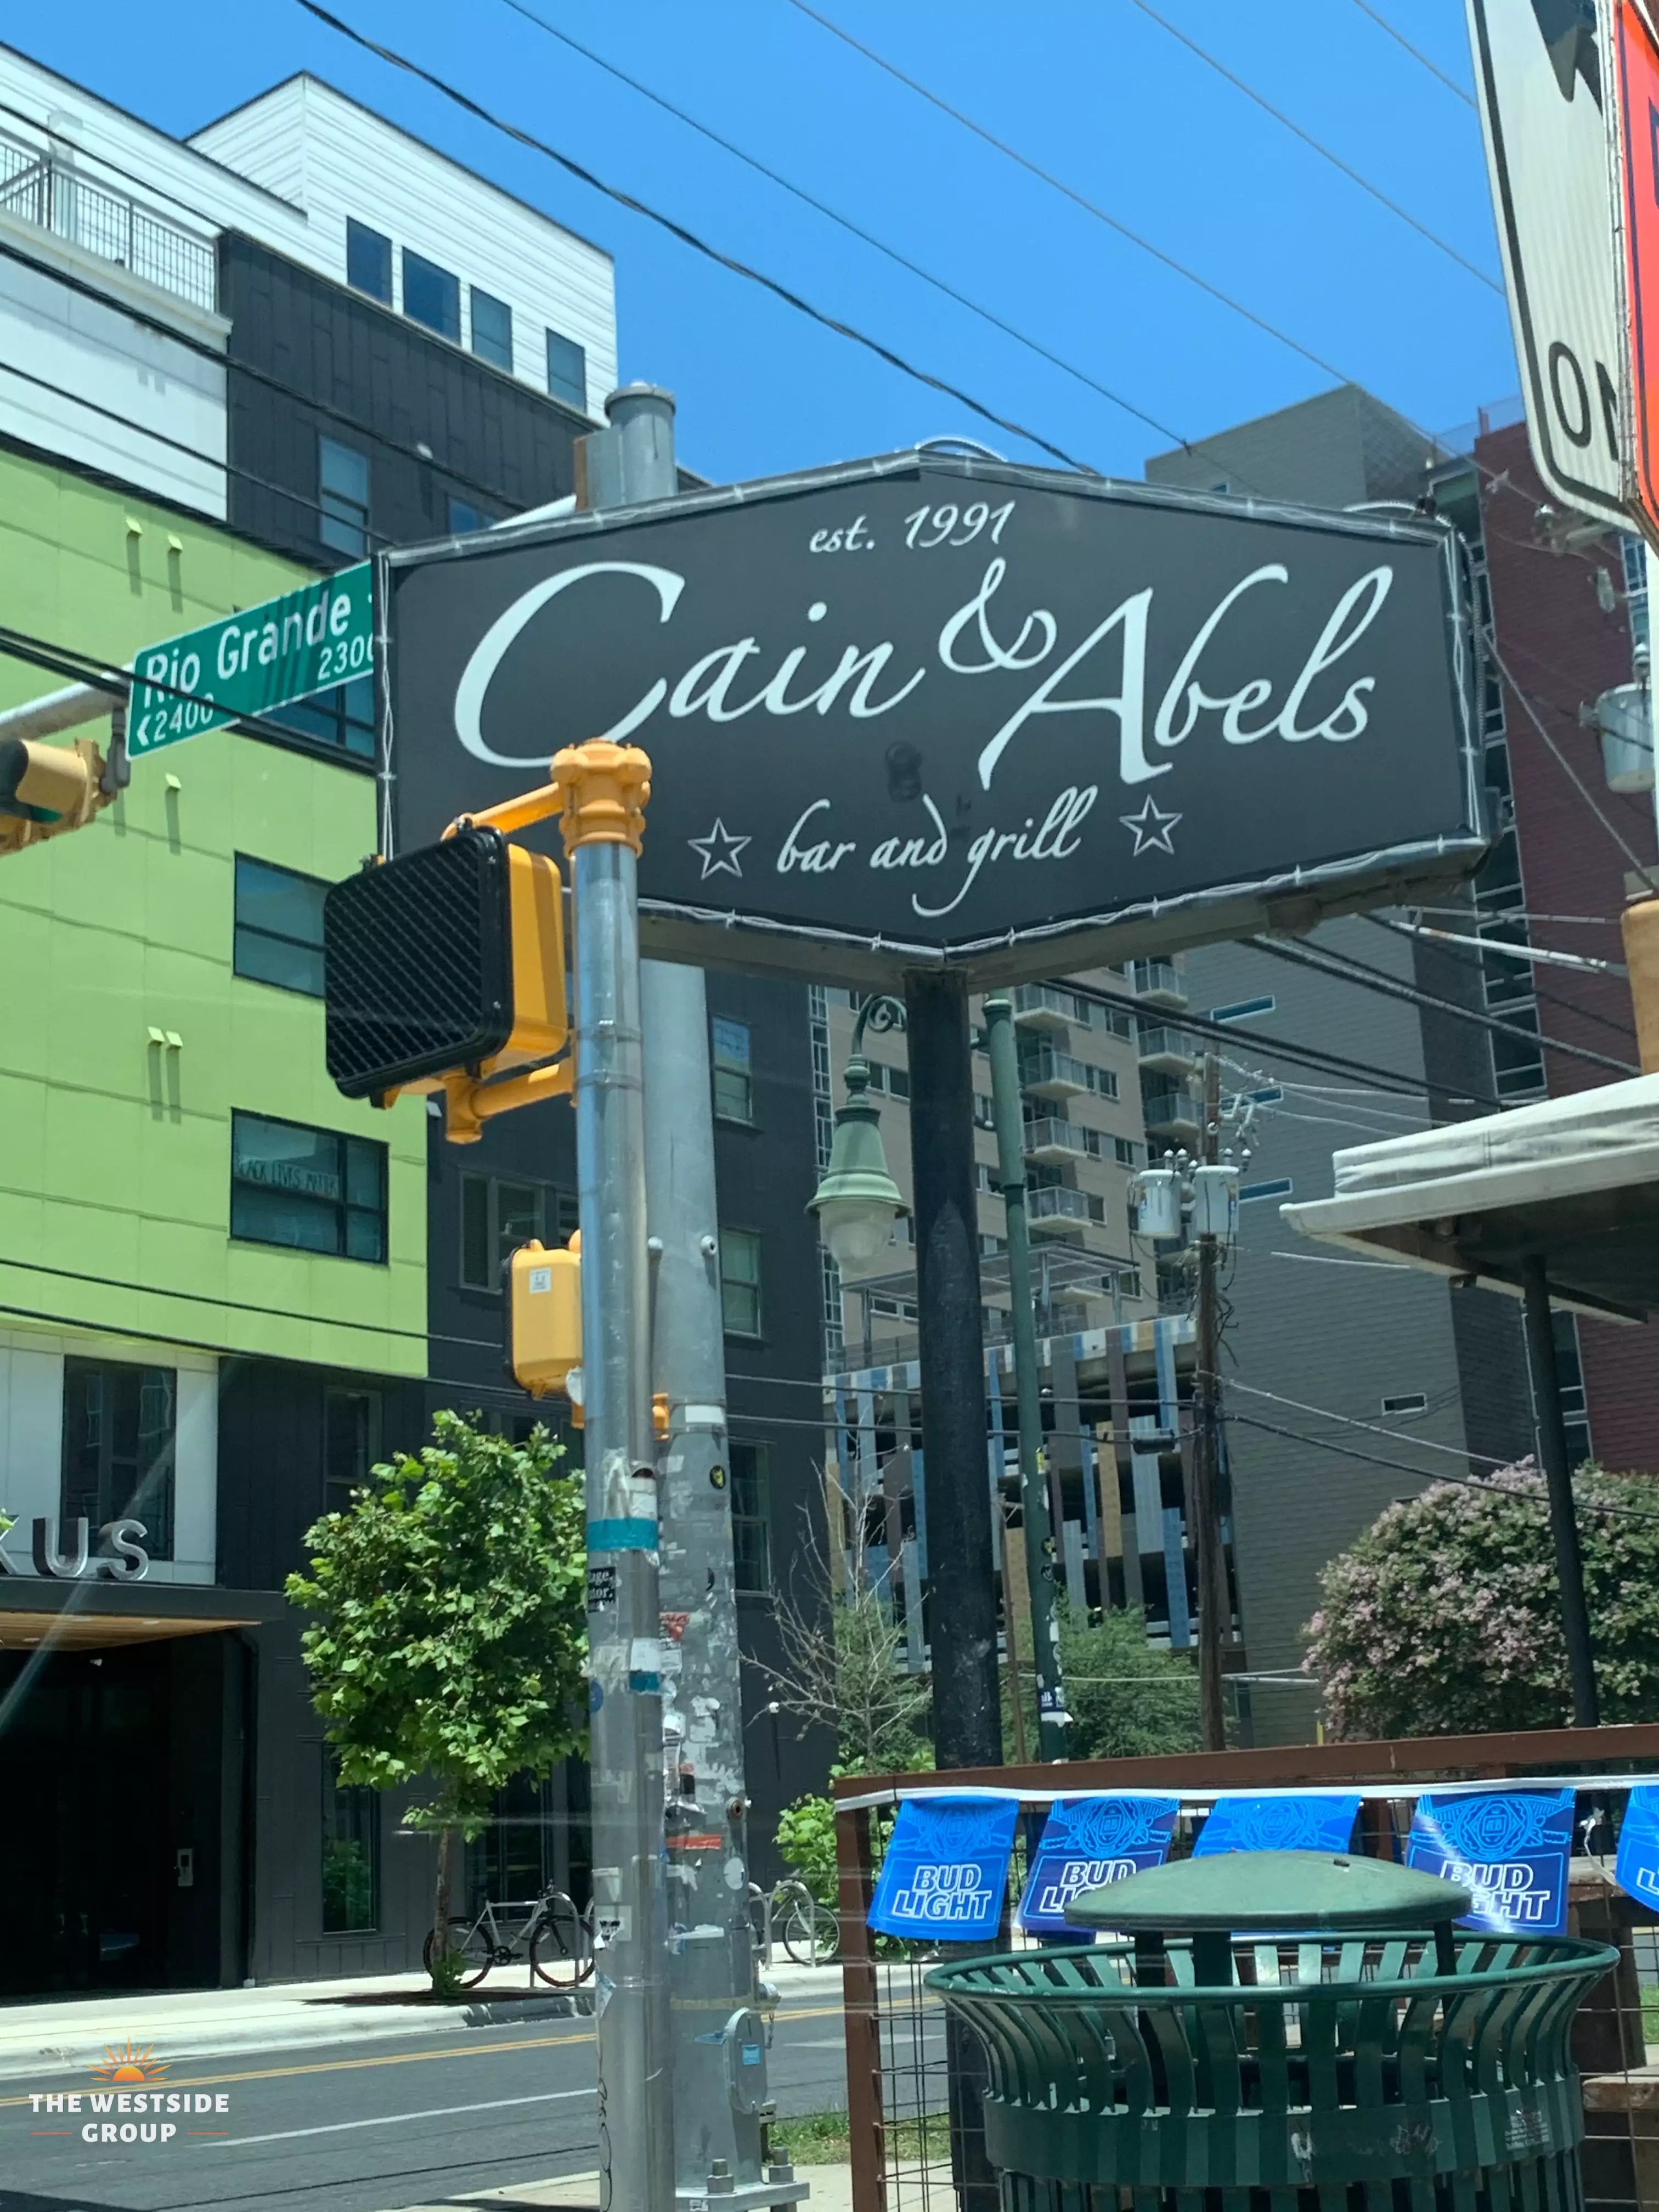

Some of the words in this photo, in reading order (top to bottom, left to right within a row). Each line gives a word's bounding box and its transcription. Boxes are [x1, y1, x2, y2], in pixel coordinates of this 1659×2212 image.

[1549, 341, 1619, 461] ON
[809, 515, 875, 553] est.
[904, 500, 1017, 550] 1991
[938, 557, 1057, 674] &
[144, 648, 200, 708] Rio
[217, 589, 352, 680] Grande
[454, 561, 926, 769] Cain
[978, 563, 1394, 791] Abels
[153, 692, 215, 742] 2400
[776, 798, 856, 873] bar
[870, 793, 948, 869] and
[912, 785, 1098, 917] grill
[912, 1863, 982, 1893] BUD
[1060, 1858, 1137, 1889] BUD
[1440, 1859, 1534, 1892] BUD
[891, 1889, 992, 1920] LIGHT
[1471, 1890, 1551, 1920] GHT
